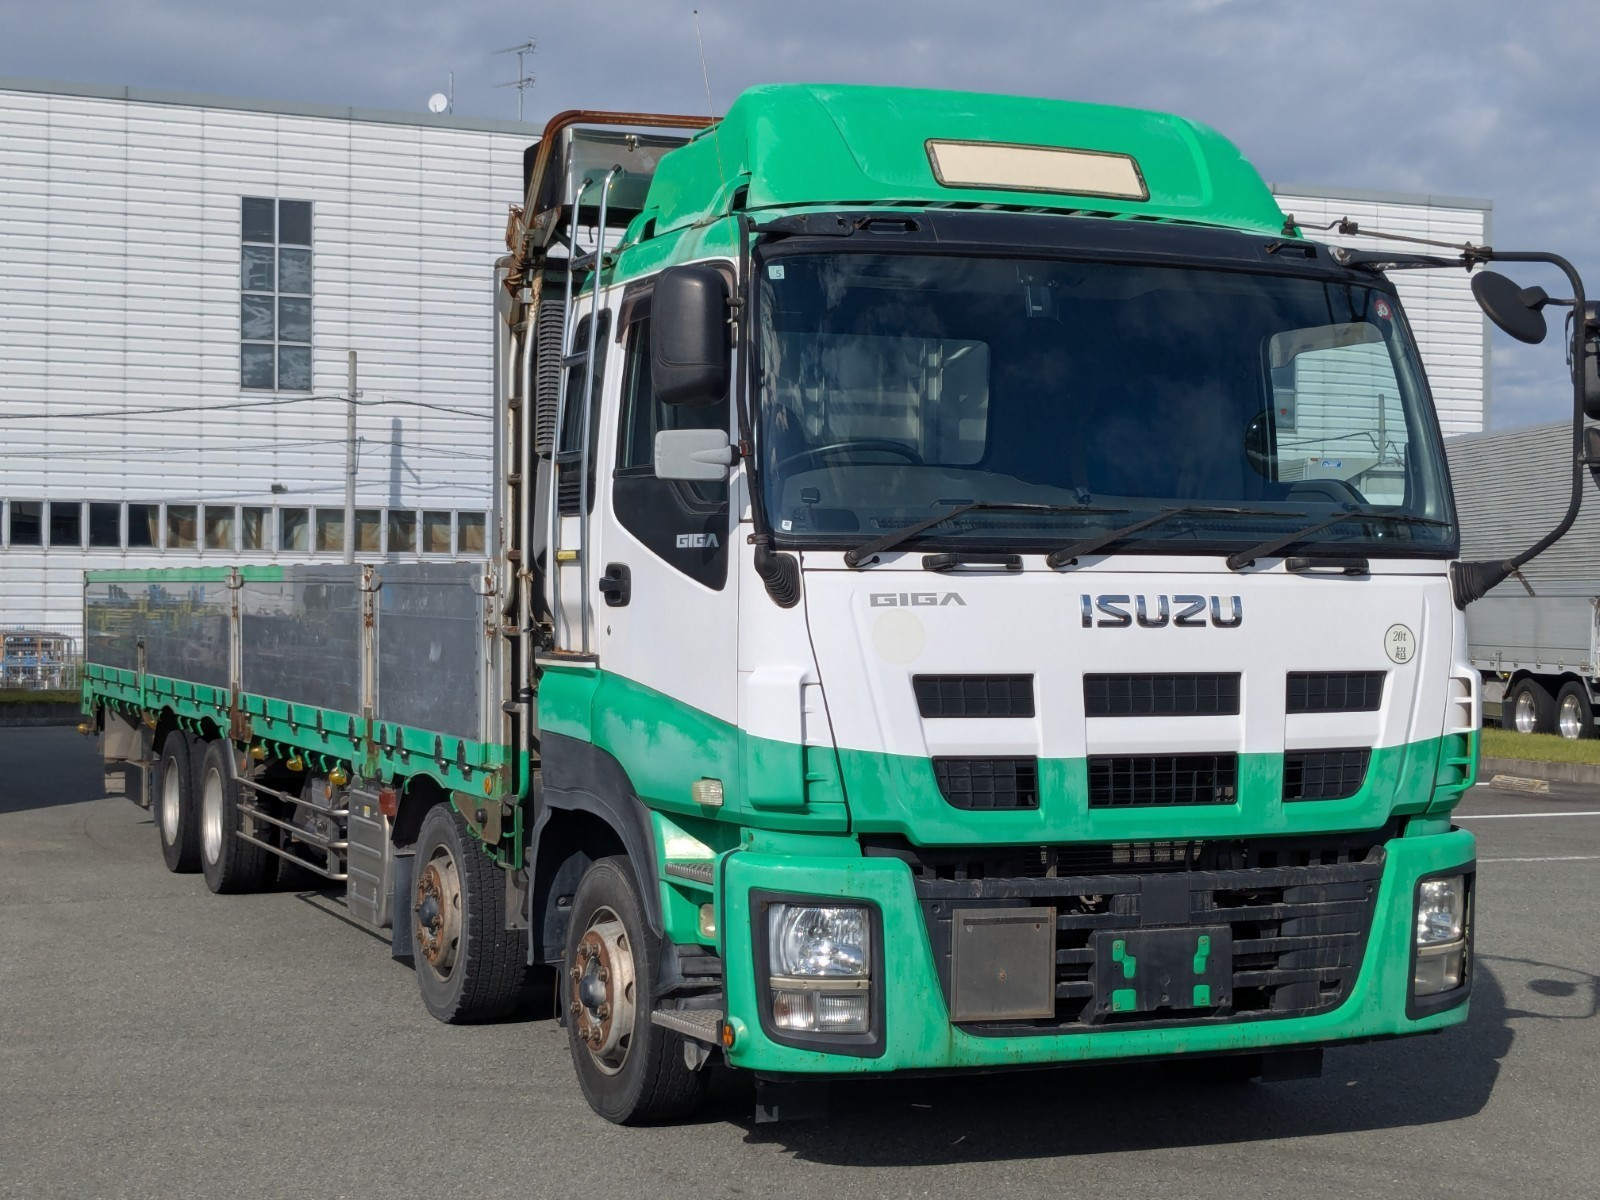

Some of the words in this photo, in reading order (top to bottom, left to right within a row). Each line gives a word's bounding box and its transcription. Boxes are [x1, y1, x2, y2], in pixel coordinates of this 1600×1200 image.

[676, 533, 720, 548] GIGA
[869, 592, 967, 607] GIGA
[1080, 594, 1243, 629] ISUZU
[1392, 630, 1408, 642] 20t
[1394, 645, 1407, 660] 超
